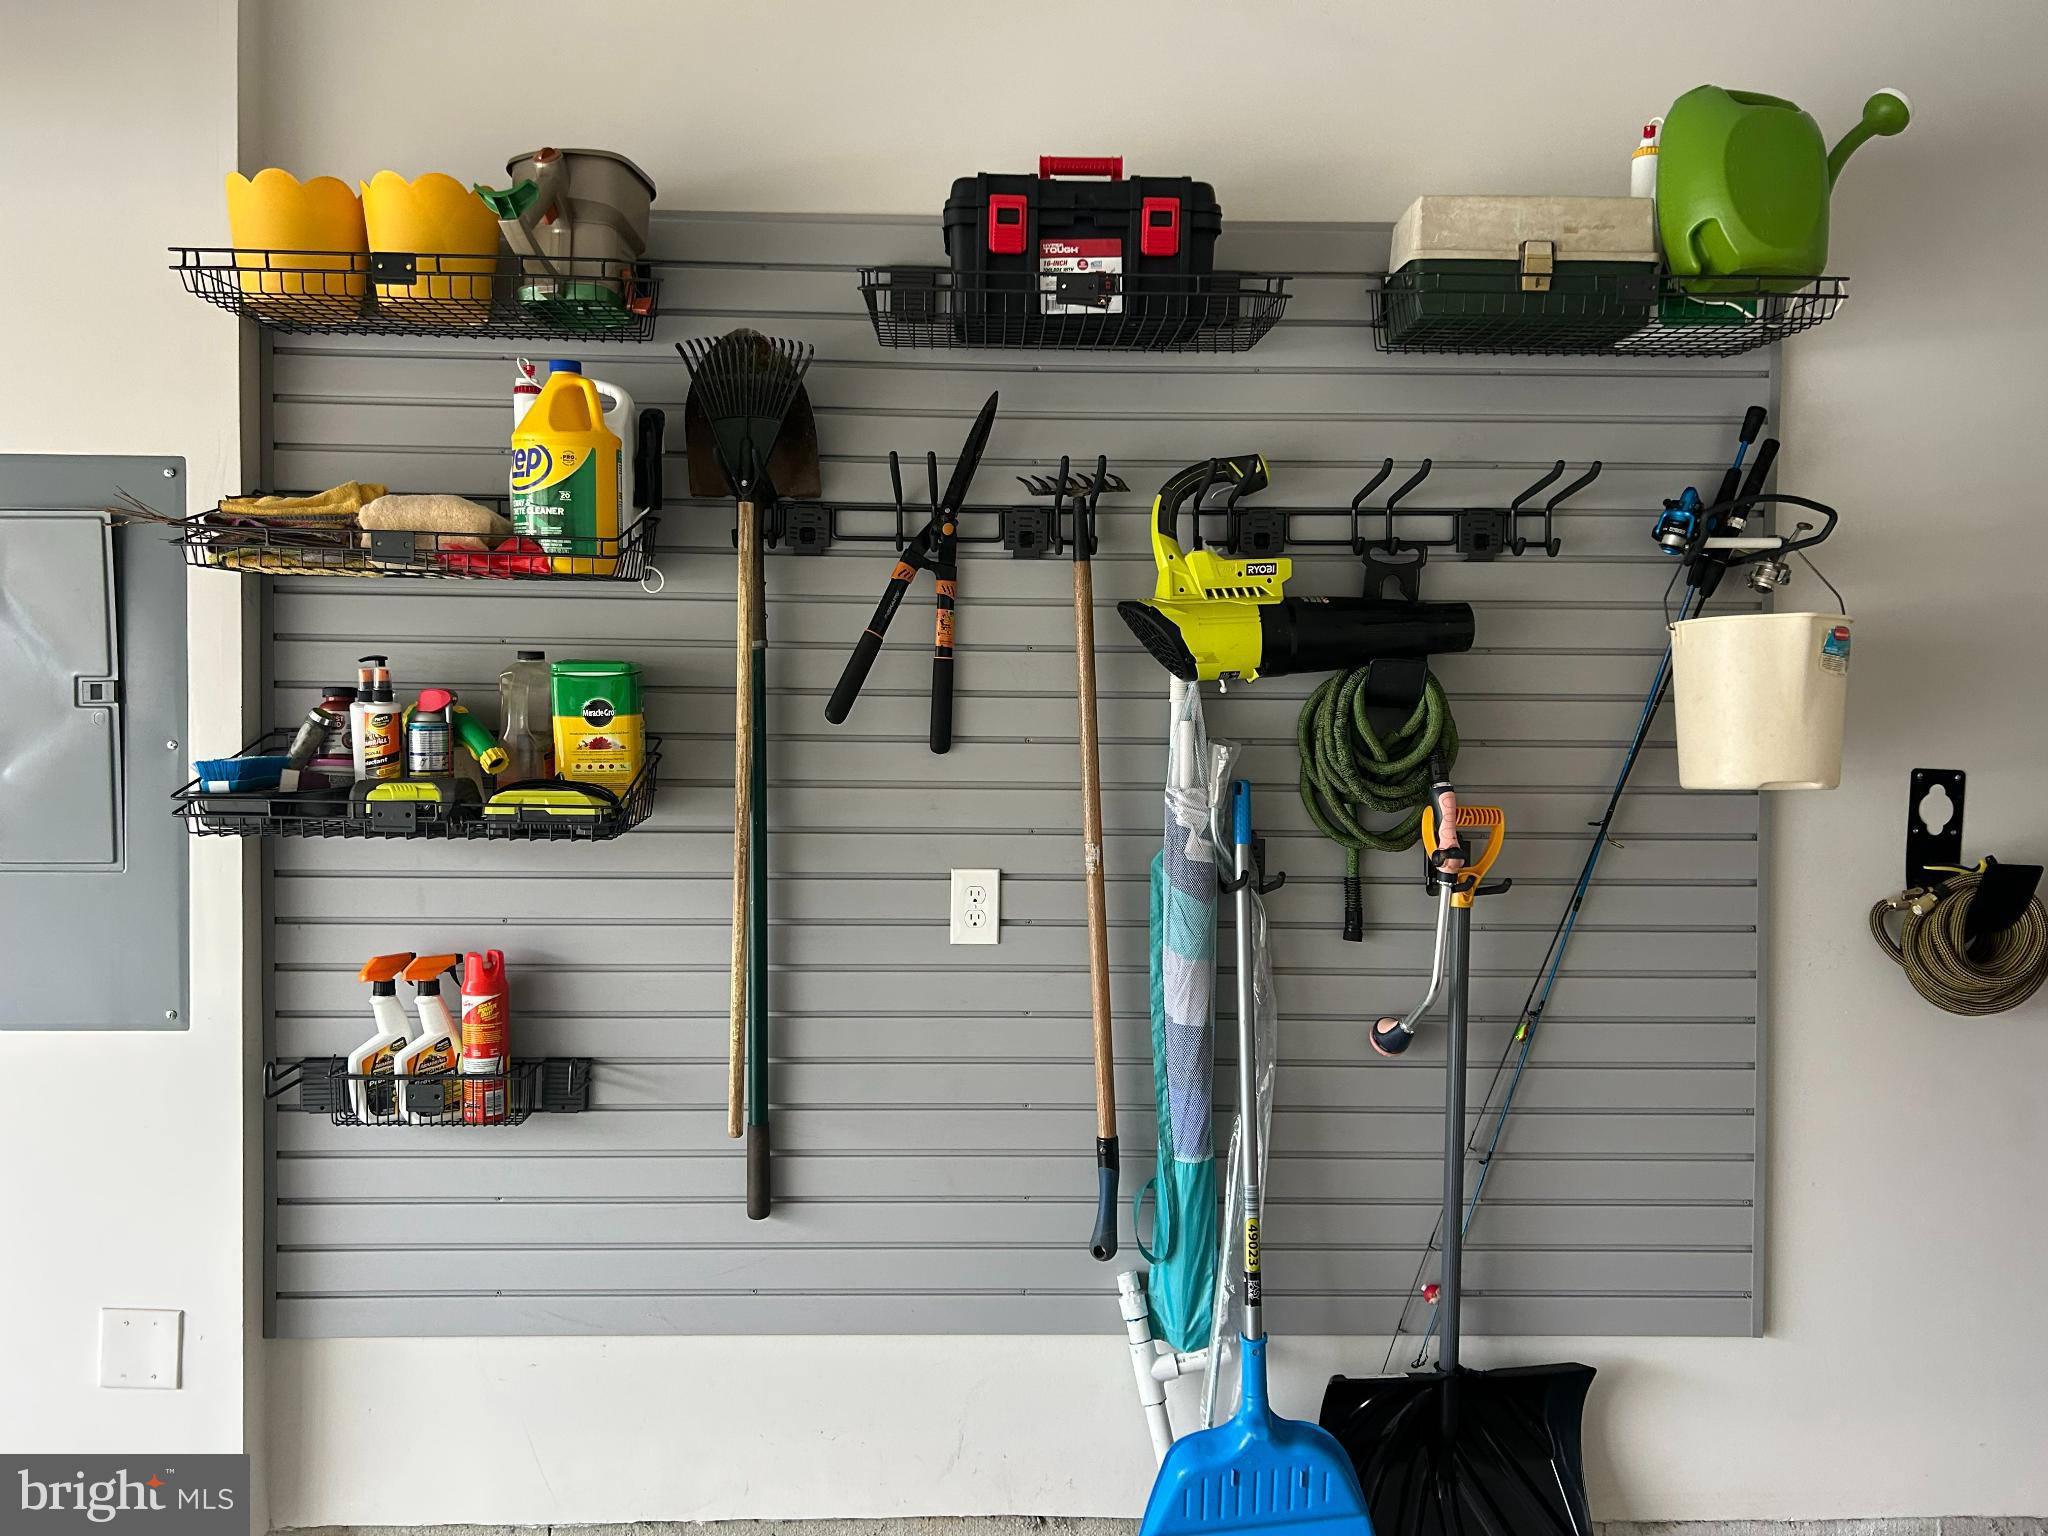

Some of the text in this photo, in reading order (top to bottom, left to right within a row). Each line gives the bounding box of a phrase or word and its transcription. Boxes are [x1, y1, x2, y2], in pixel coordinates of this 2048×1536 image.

[1043, 246, 1080, 254] TOUGH
[526, 506, 565, 516] CLEANER
[1247, 565, 1275, 574] RYOBI
[582, 708, 615, 717] Miracle-Gro
[1248, 1224, 1259, 1266] 49023
